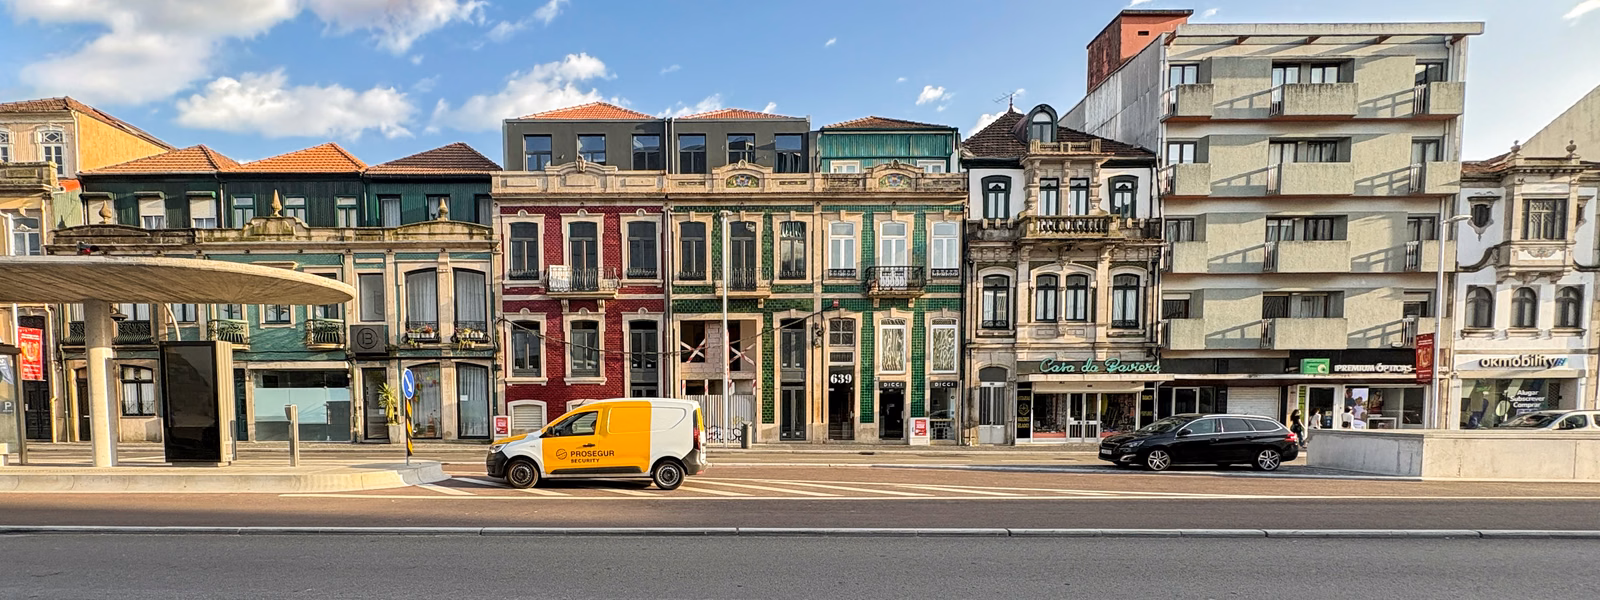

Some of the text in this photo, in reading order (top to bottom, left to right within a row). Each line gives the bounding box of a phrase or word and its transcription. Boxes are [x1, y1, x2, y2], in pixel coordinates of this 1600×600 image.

[1039, 357, 1161, 373] Casa da Baviera
[1334, 364, 1375, 372] PREMIUM
[1479, 354, 1556, 369] okmobility
[830, 373, 852, 384] 639
